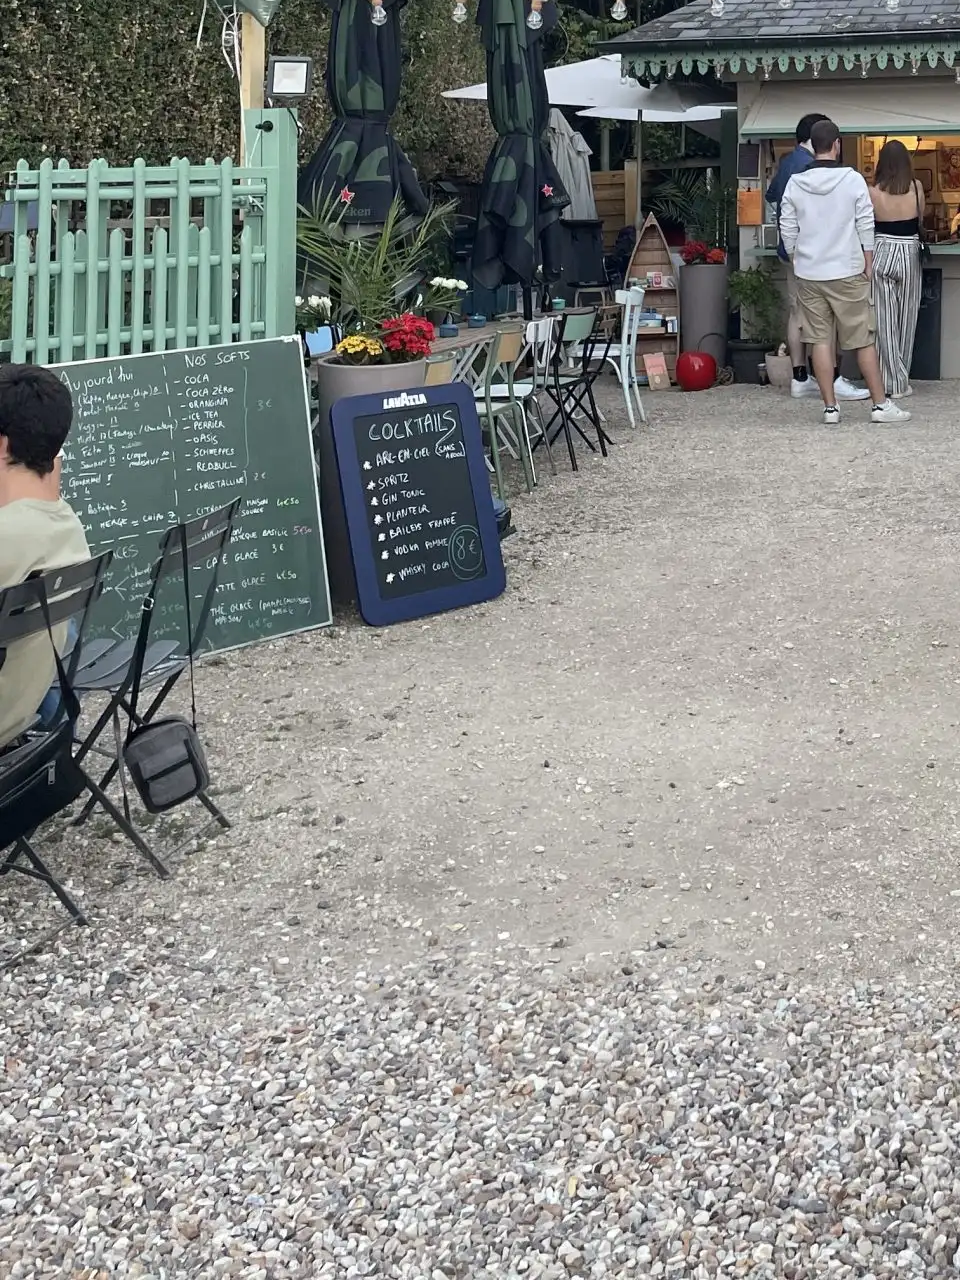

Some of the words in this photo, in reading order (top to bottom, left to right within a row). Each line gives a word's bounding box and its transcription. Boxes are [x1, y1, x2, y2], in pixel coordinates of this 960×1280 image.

[184, 353, 207, 368] NOS
[214, 350, 250, 366] SOFTS
[184, 373, 209, 385] COCA
[185, 387, 209, 398] COCA
[188, 397, 229, 409] ORANGINA
[204, 409, 218, 419] TEA
[193, 420, 225, 431] PERRIER
[368, 410, 457, 442] COCKTAILS
[381, 492, 398, 505] GIN
